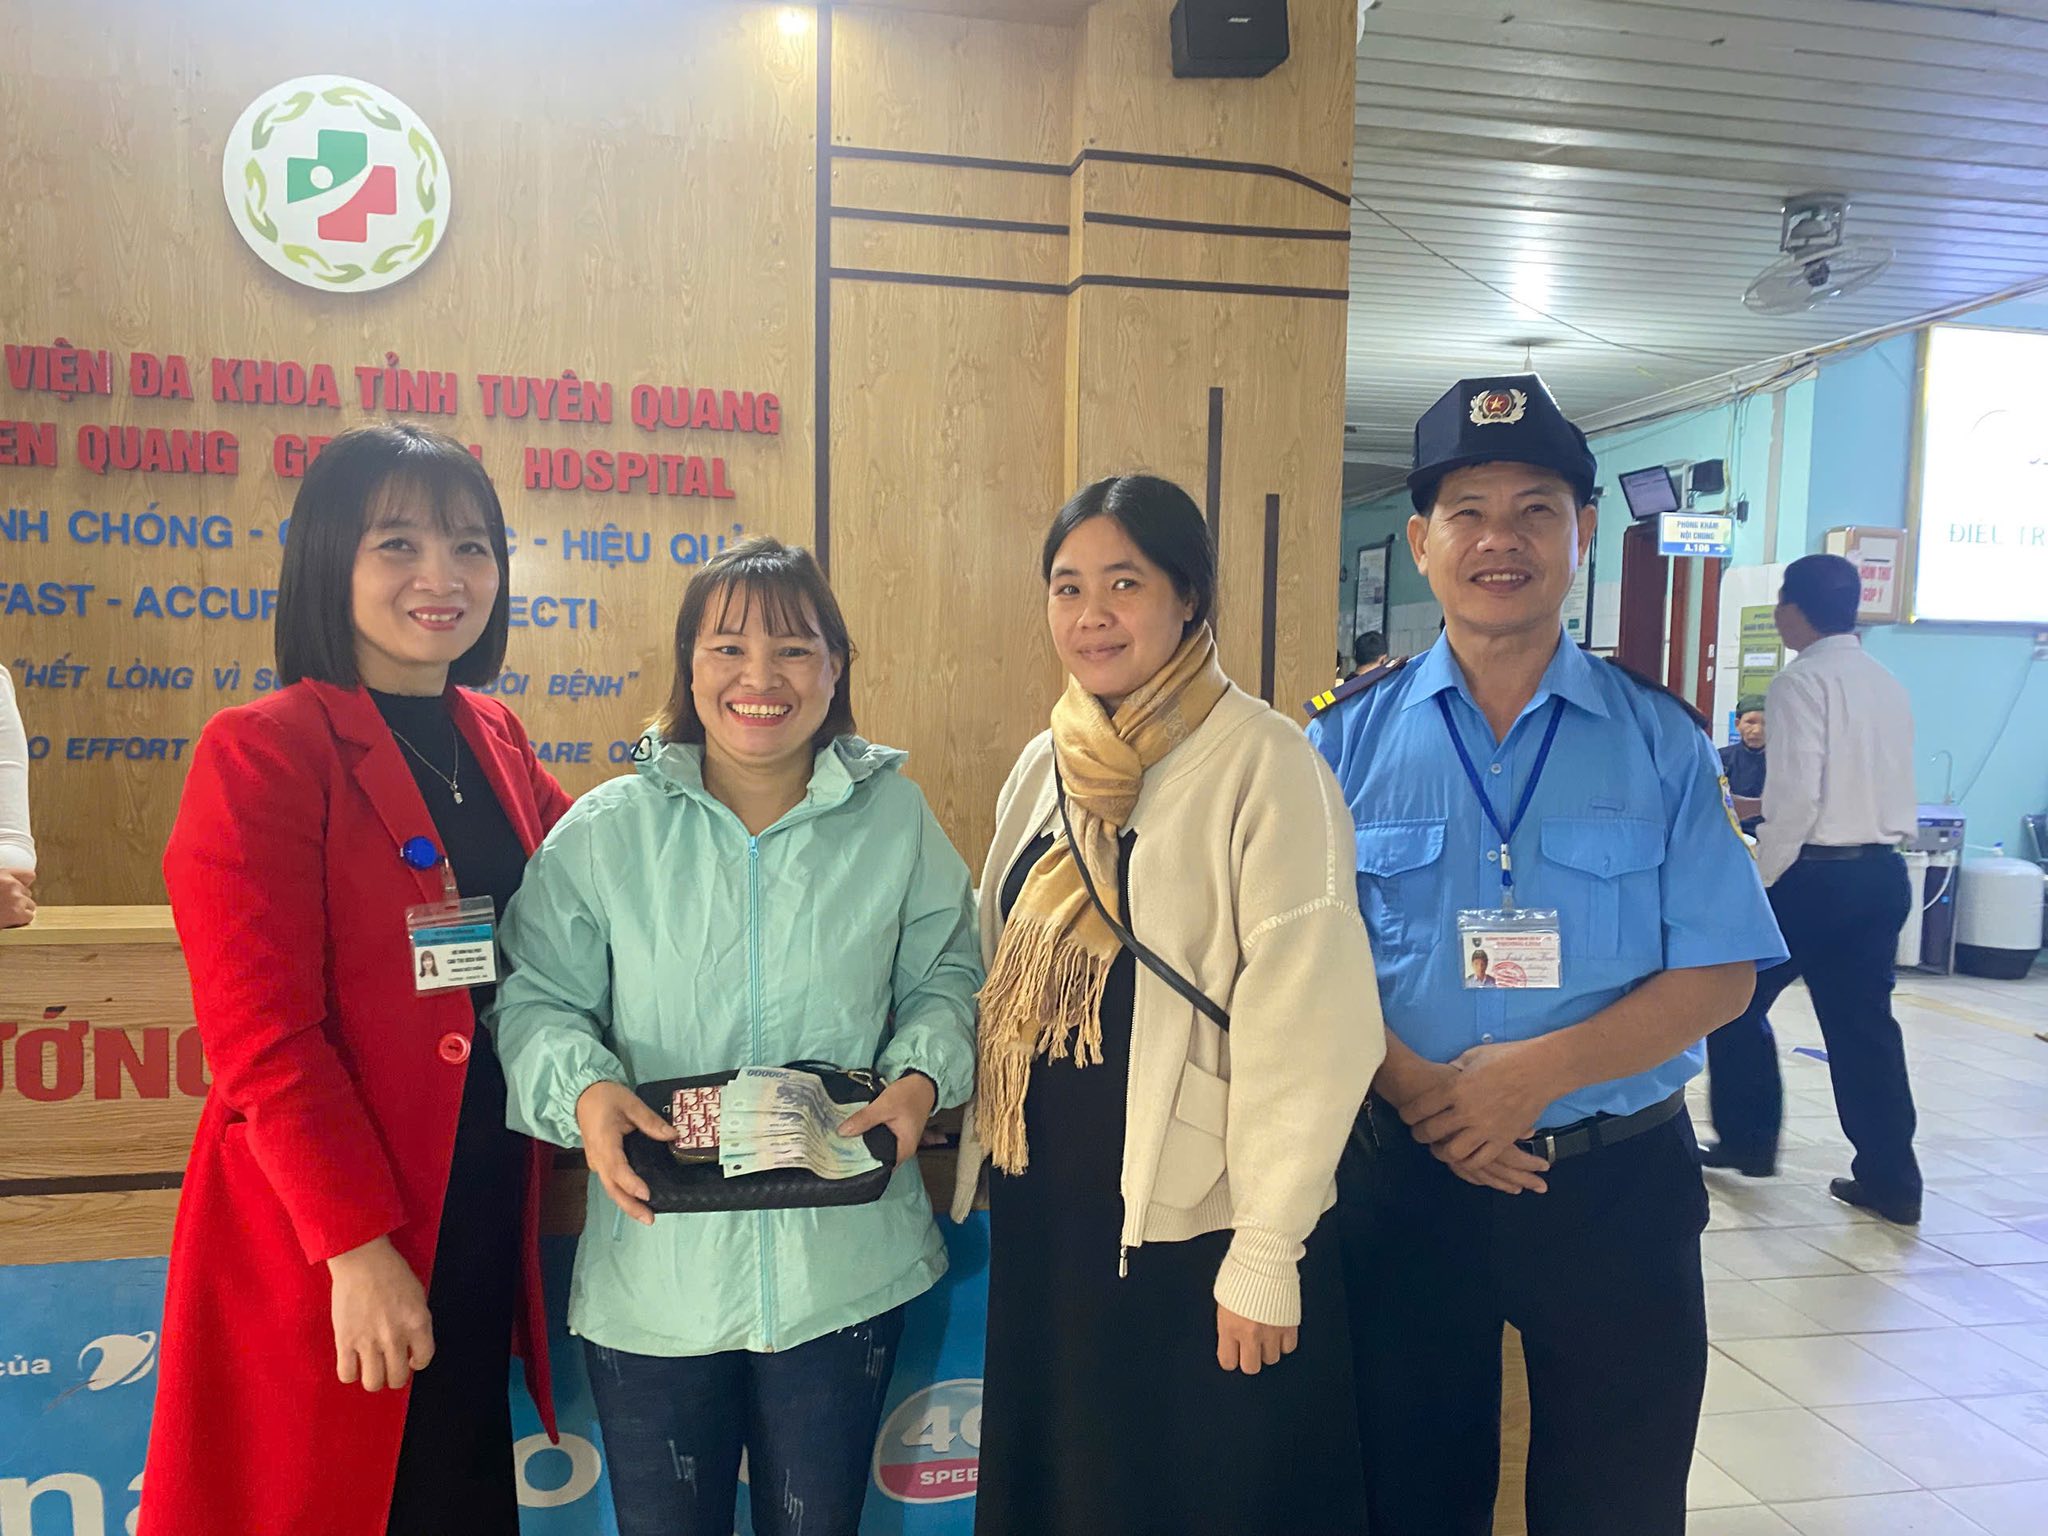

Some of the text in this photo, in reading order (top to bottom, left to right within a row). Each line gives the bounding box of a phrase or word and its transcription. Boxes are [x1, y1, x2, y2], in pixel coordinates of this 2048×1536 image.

[5, 337, 781, 435] VIỆN ĐA KHOA TỈNH TUYÊN QUANG
[78, 424, 239, 475] QUANG
[524, 446, 735, 499] HOSPITAL
[68, 502, 233, 548] CHÓNG
[562, 522, 650, 569] HIỆU
[670, 523, 744, 566] QU
[107, 657, 194, 690] LÒNG
[214, 659, 241, 691] VÌ
[66, 737, 190, 762] EFFORT
[529, 740, 593, 763] ARE
